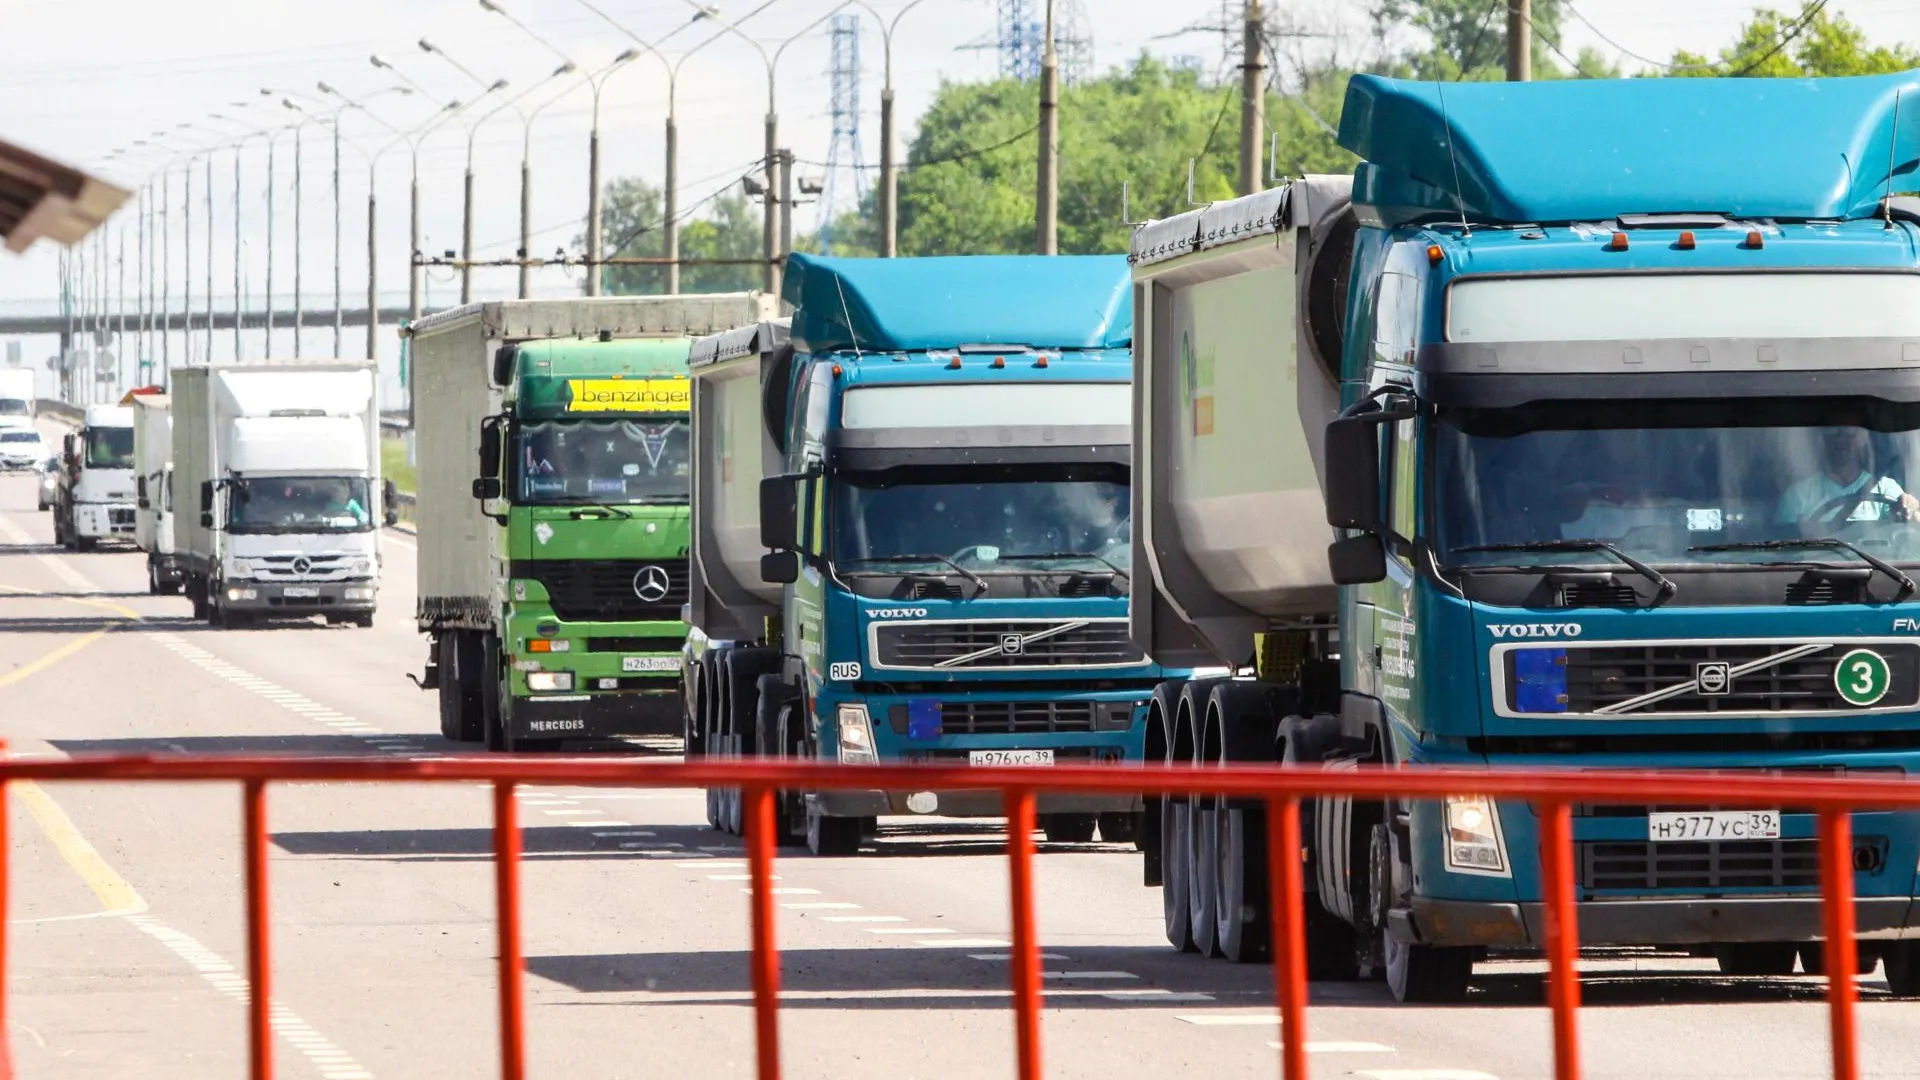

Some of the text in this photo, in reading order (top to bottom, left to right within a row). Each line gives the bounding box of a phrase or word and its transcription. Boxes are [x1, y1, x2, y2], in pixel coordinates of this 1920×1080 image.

[865, 608, 928, 618] VOLVO
[1486, 623, 1582, 638] VOLVO
[832, 664, 859, 678] RUS
[1851, 661, 1873, 694] 3
[530, 719, 585, 731] MERCEDES
[1751, 815, 1771, 830] 39
